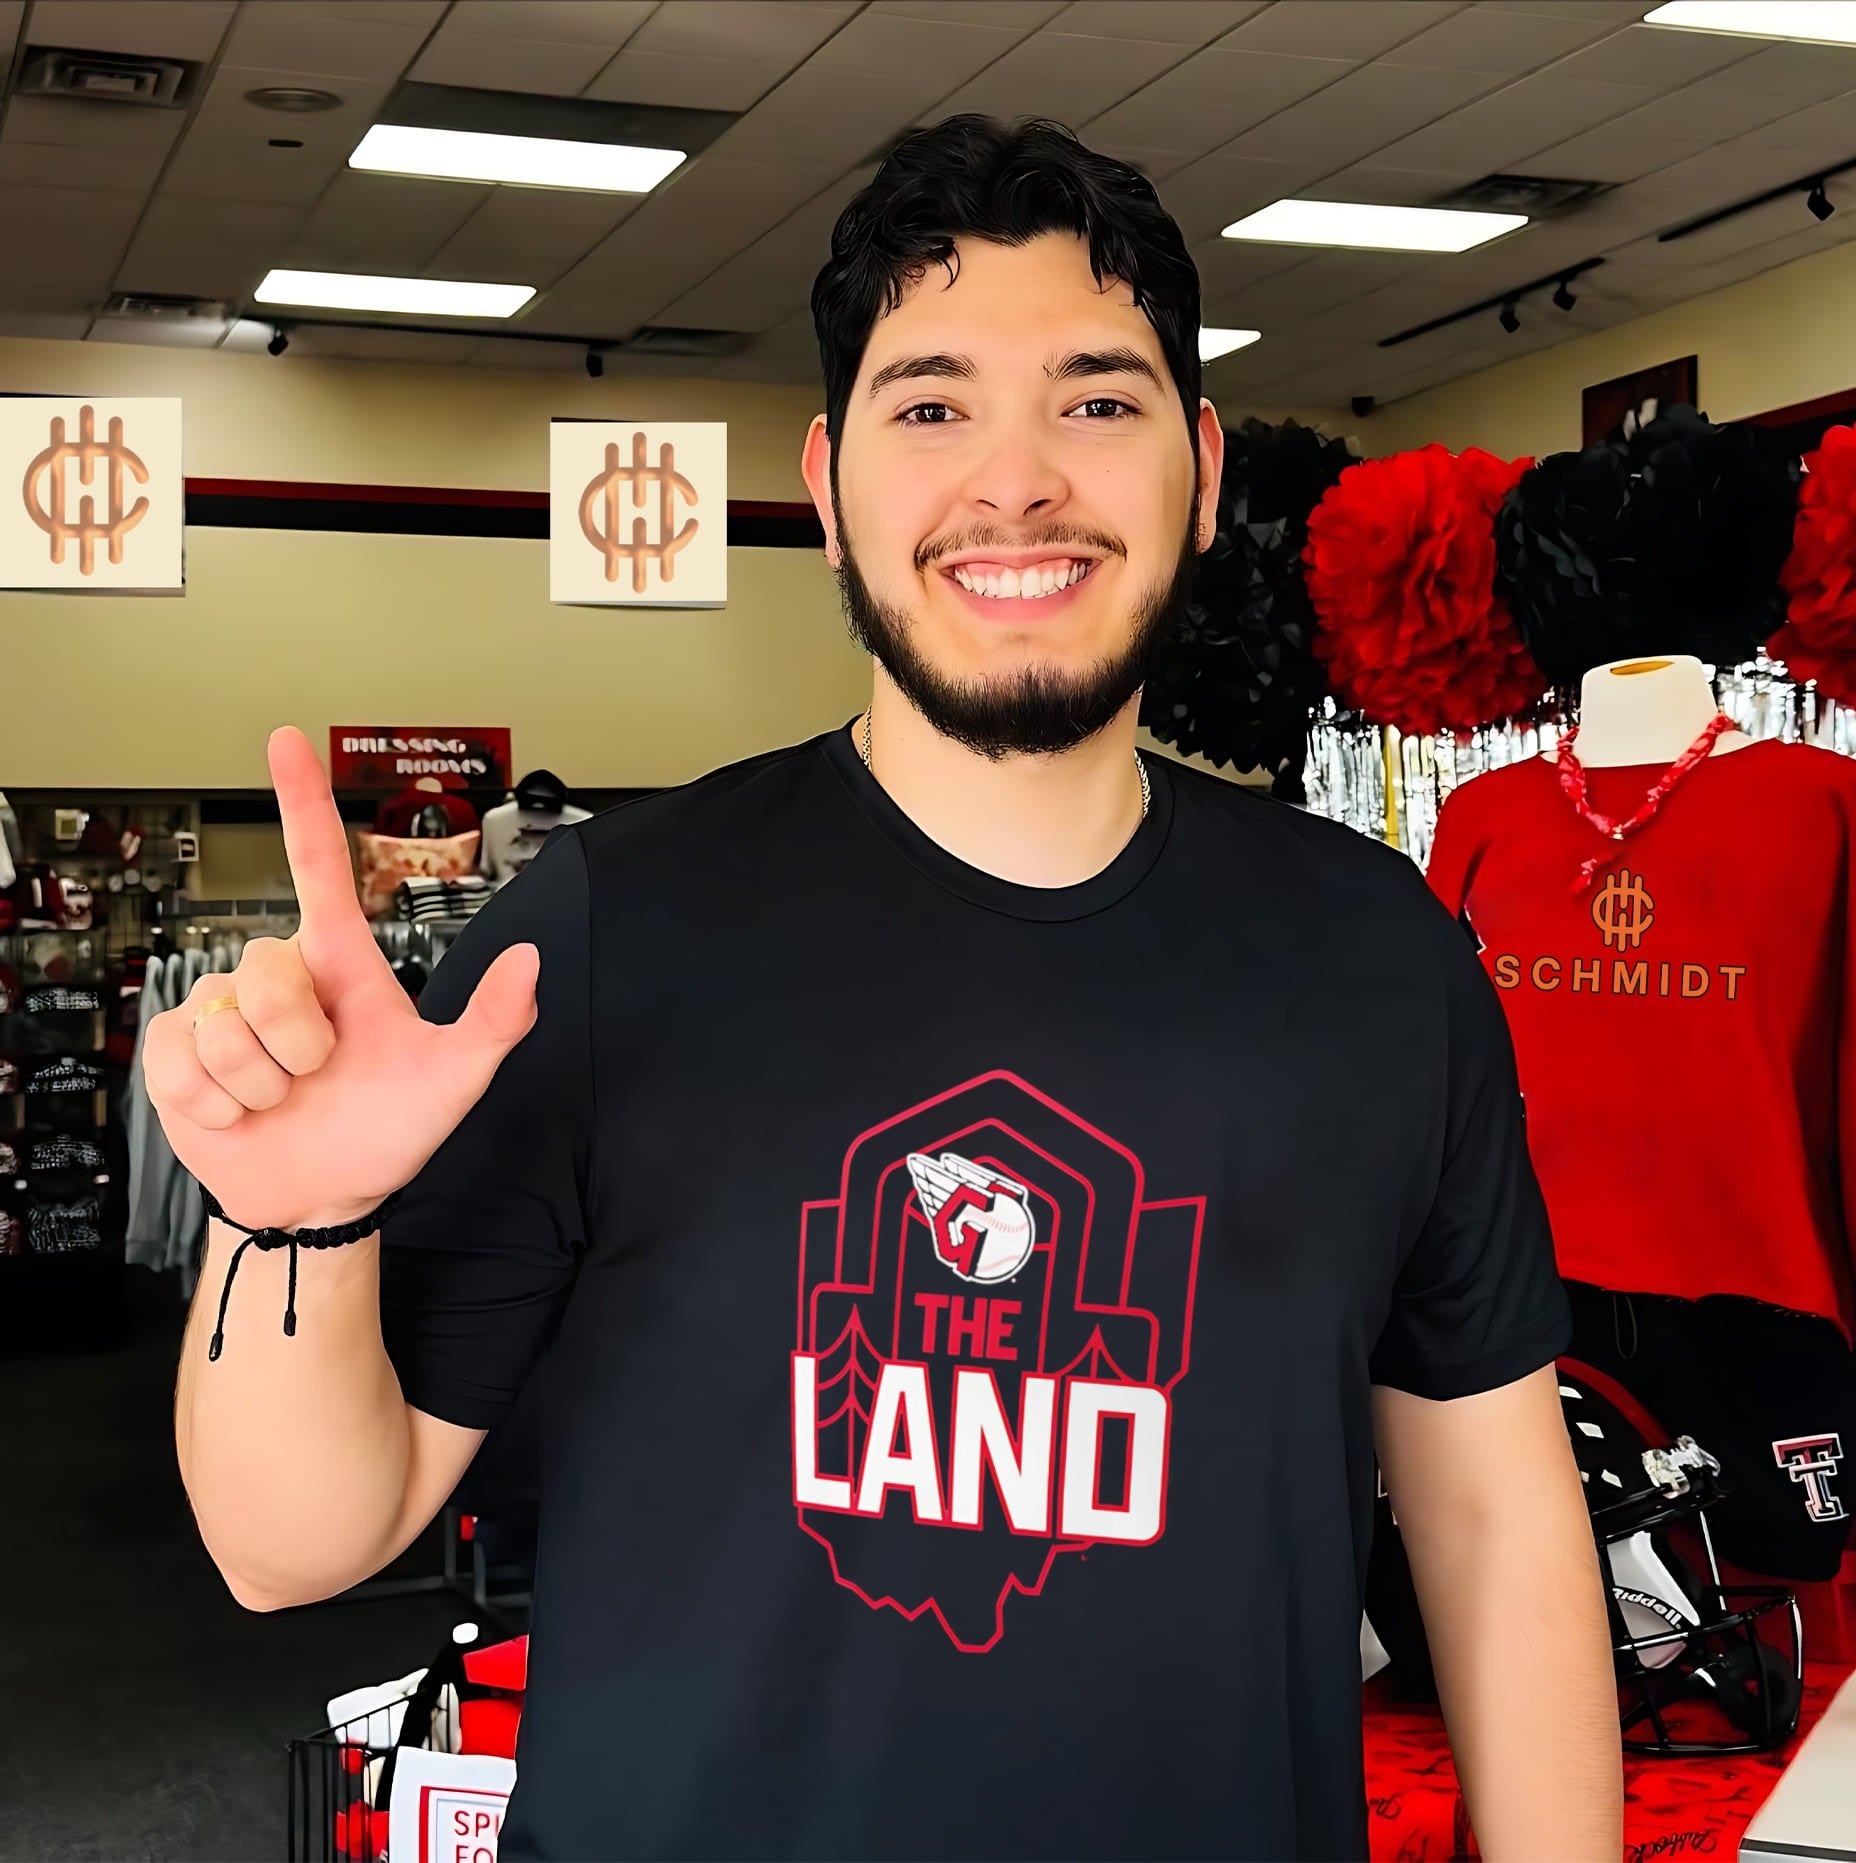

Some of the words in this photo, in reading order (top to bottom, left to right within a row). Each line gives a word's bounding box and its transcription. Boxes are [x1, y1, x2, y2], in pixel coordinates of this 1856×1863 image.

[396, 758, 487, 774] ROOMS
[1493, 953, 1747, 1001] SCHMIDT
[914, 1292, 1022, 1361] THE
[790, 1350, 1172, 1547] LAND
